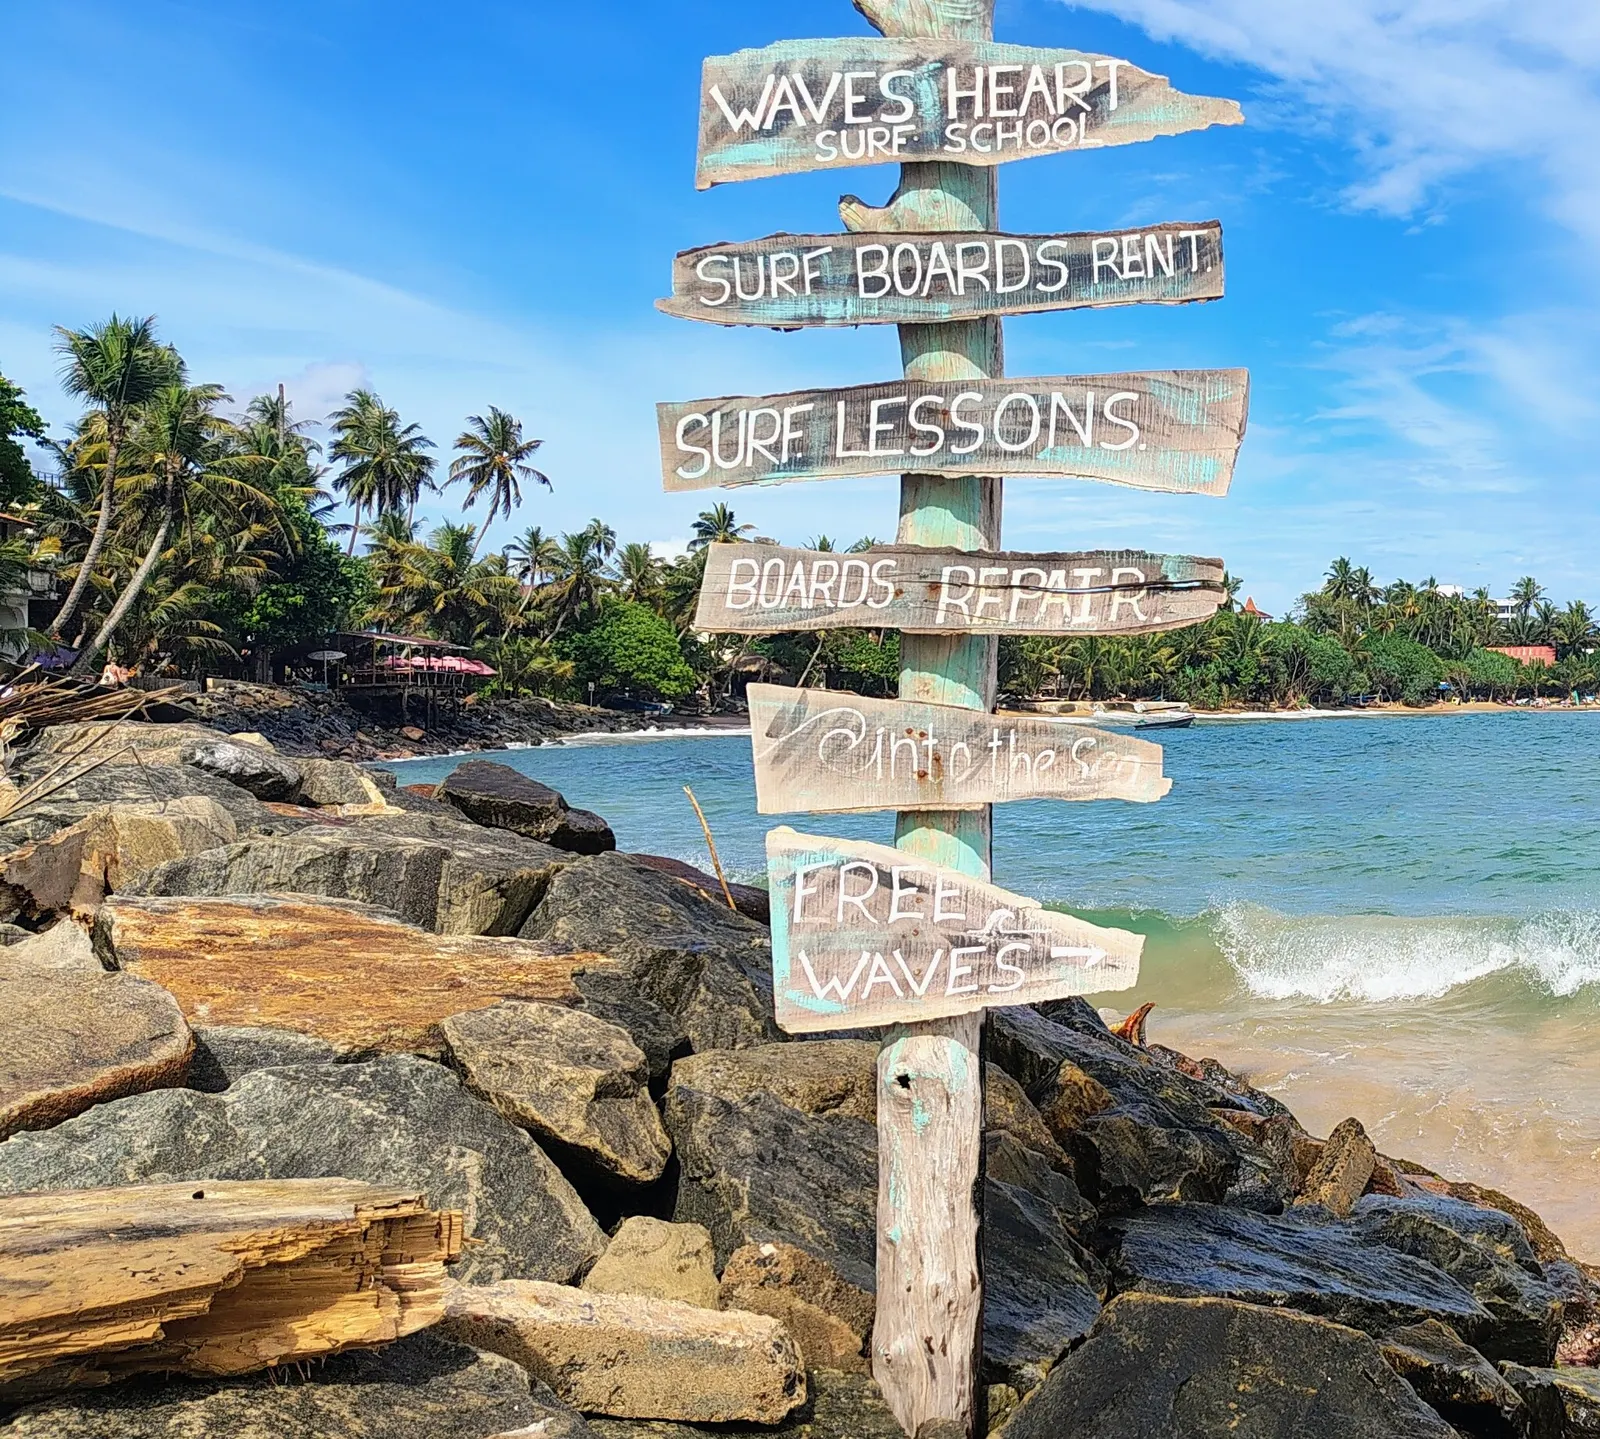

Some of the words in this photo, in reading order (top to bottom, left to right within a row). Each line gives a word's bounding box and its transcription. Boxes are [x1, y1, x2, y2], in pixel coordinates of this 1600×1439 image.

[709, 69, 915, 133] WAVES
[945, 60, 1132, 119] HEART
[944, 113, 1103, 152] SCHOOL
[696, 246, 832, 306] SURF
[856, 239, 1069, 299] BOARDS
[725, 558, 898, 610] BOARDS
[988, 728, 1055, 784] the
[792, 862, 966, 925] FREE
[799, 943, 1032, 1000] WAVES
